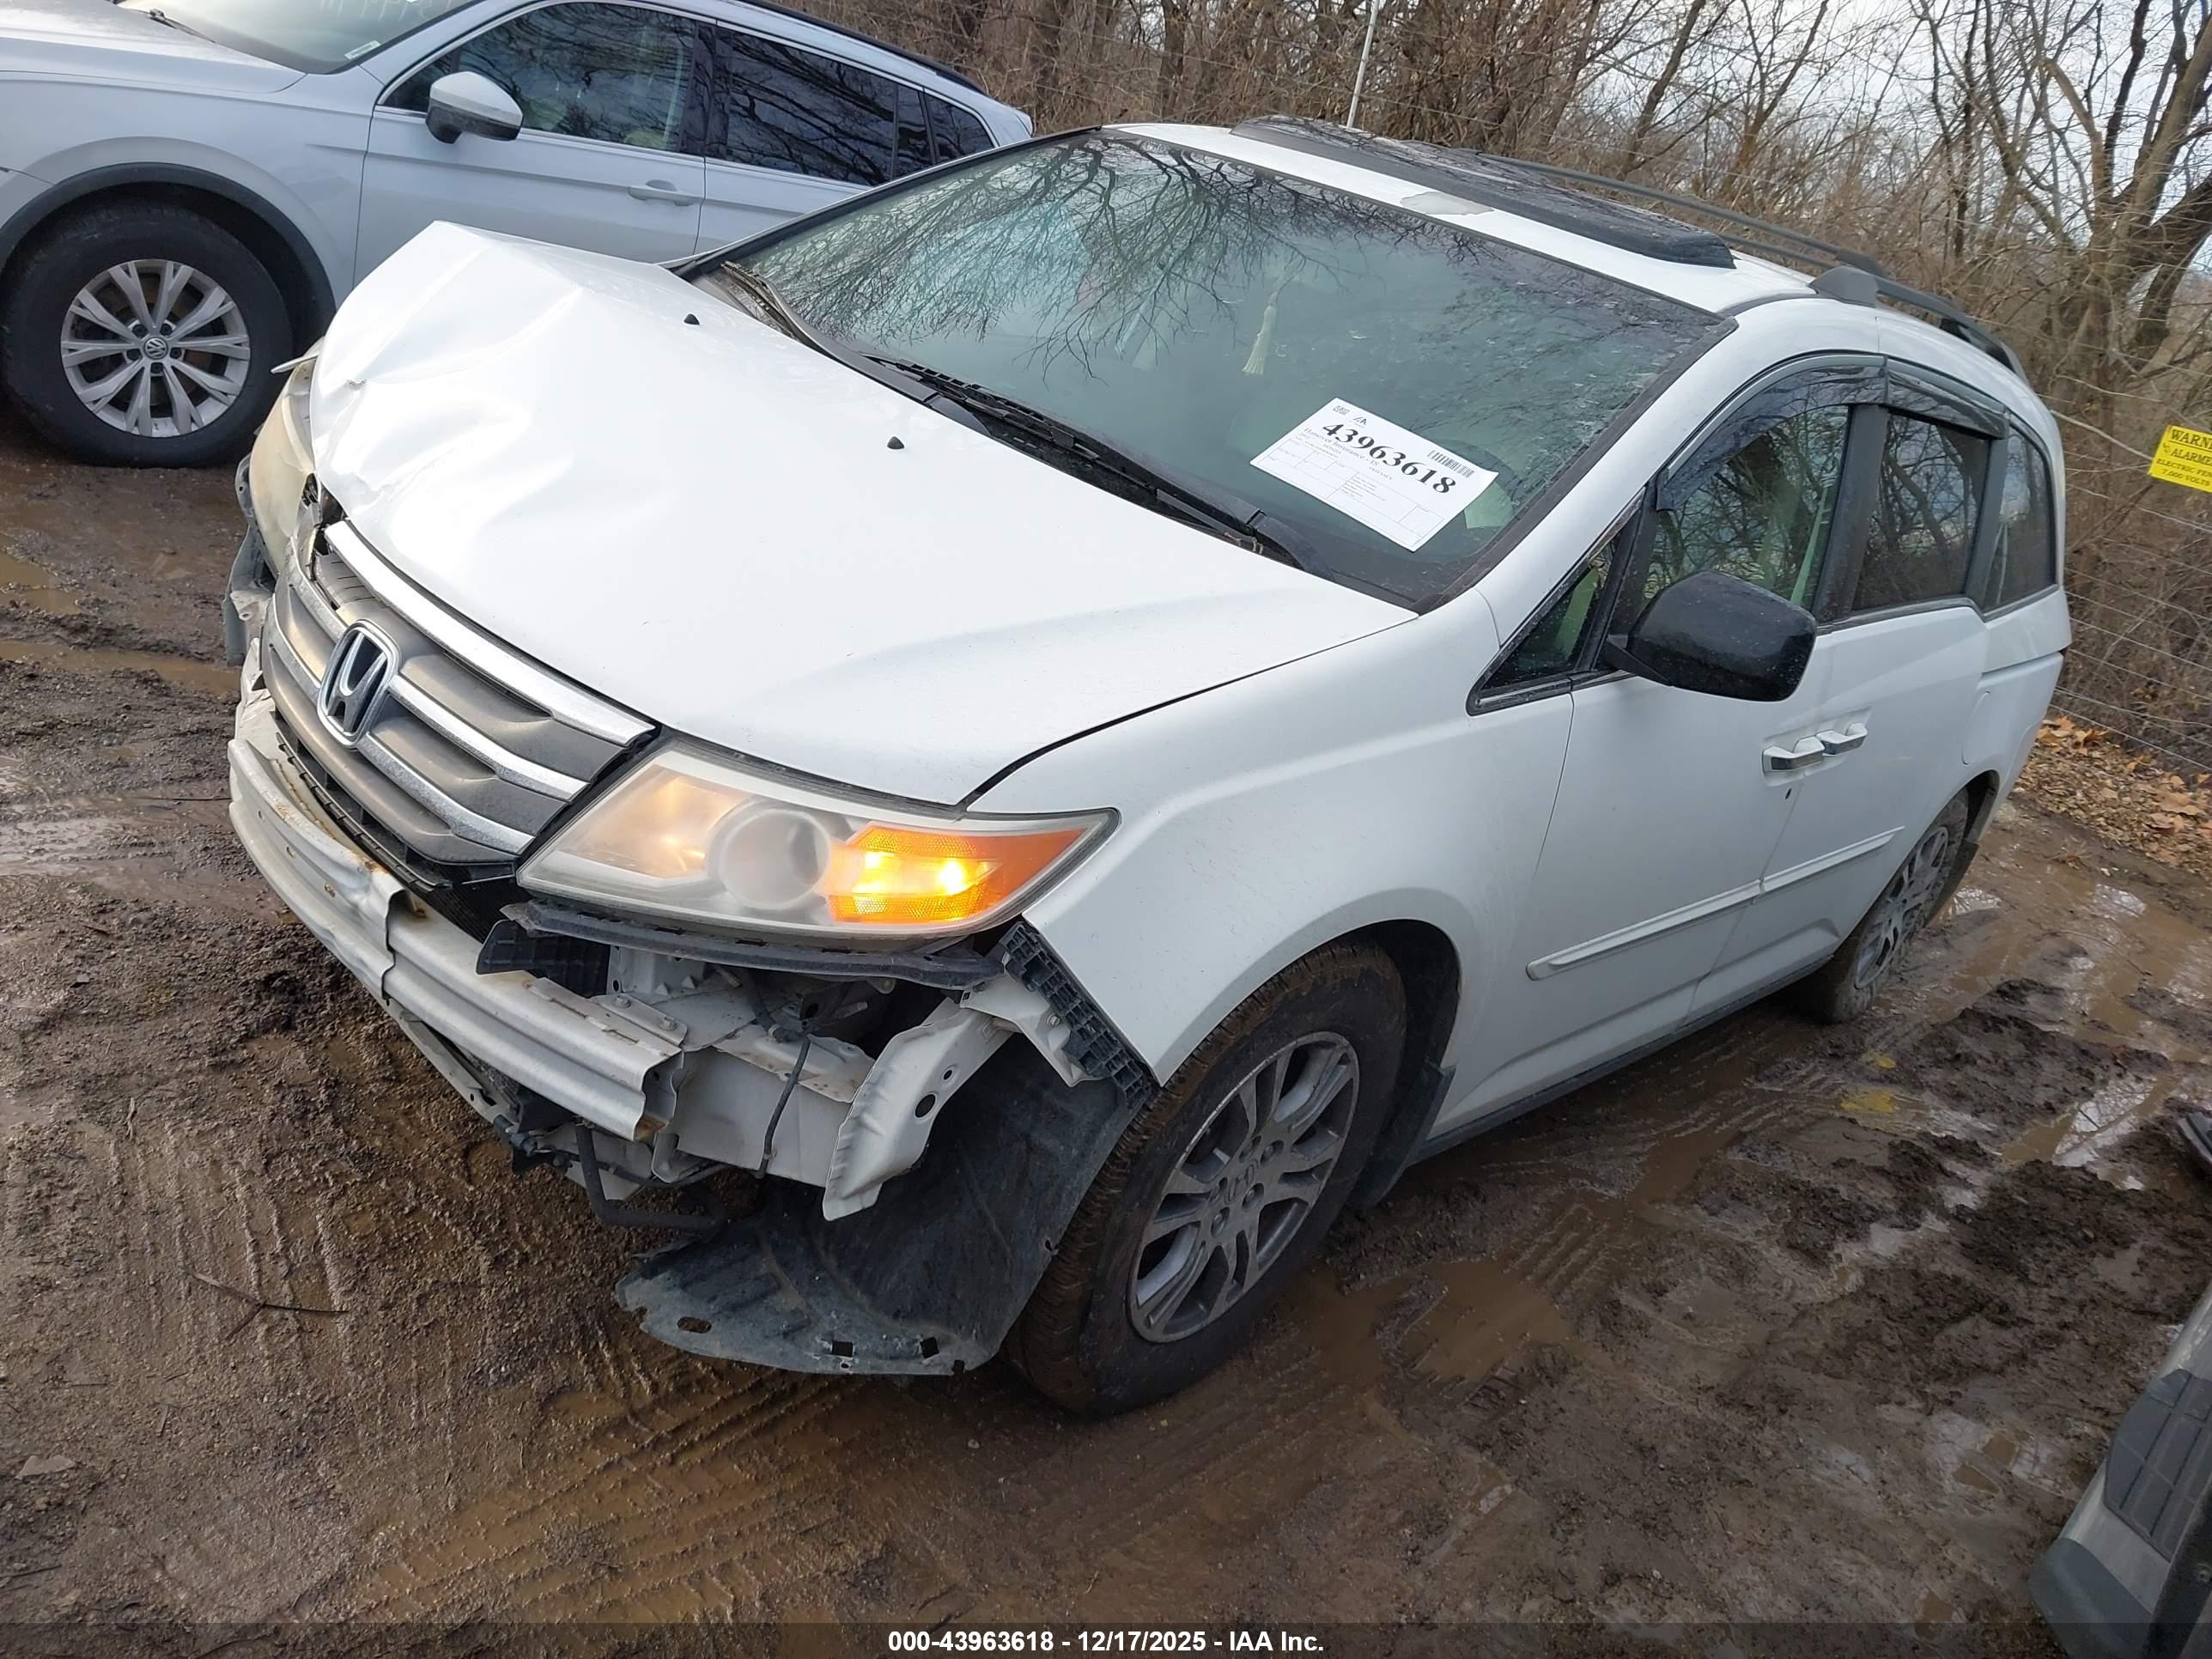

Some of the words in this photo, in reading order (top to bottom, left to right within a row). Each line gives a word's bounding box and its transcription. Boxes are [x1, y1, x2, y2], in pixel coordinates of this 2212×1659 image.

[1322, 424, 1455, 493] 43963618
[2157, 459, 2198, 473] ELECTRIC
[2185, 475, 2211, 487] VOLTS
